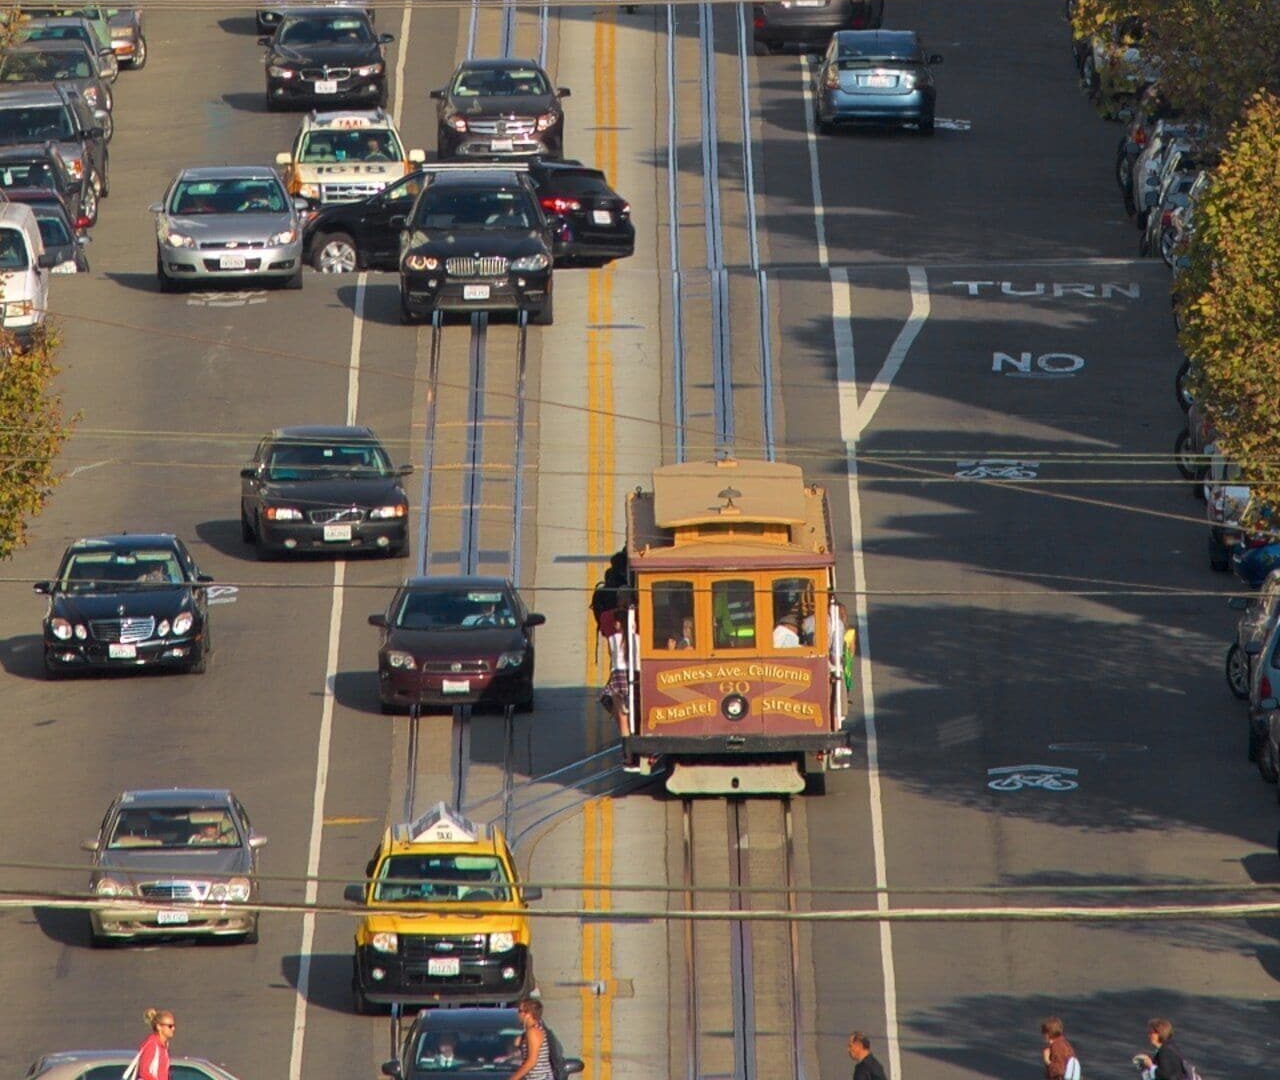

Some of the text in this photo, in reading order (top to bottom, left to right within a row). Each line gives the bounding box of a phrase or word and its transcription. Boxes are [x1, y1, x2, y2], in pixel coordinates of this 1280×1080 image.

[338, 119, 363, 127] TAXI
[952, 281, 1141, 299] TURN
[992, 351, 1085, 373] NO
[661, 673, 681, 685] Van
[683, 669, 712, 681] Ness
[748, 665, 810, 681] California
[719, 681, 750, 694] 60
[656, 702, 712, 721] & Market
[762, 700, 814, 715] Streets
[436, 830, 453, 840] TAXI
